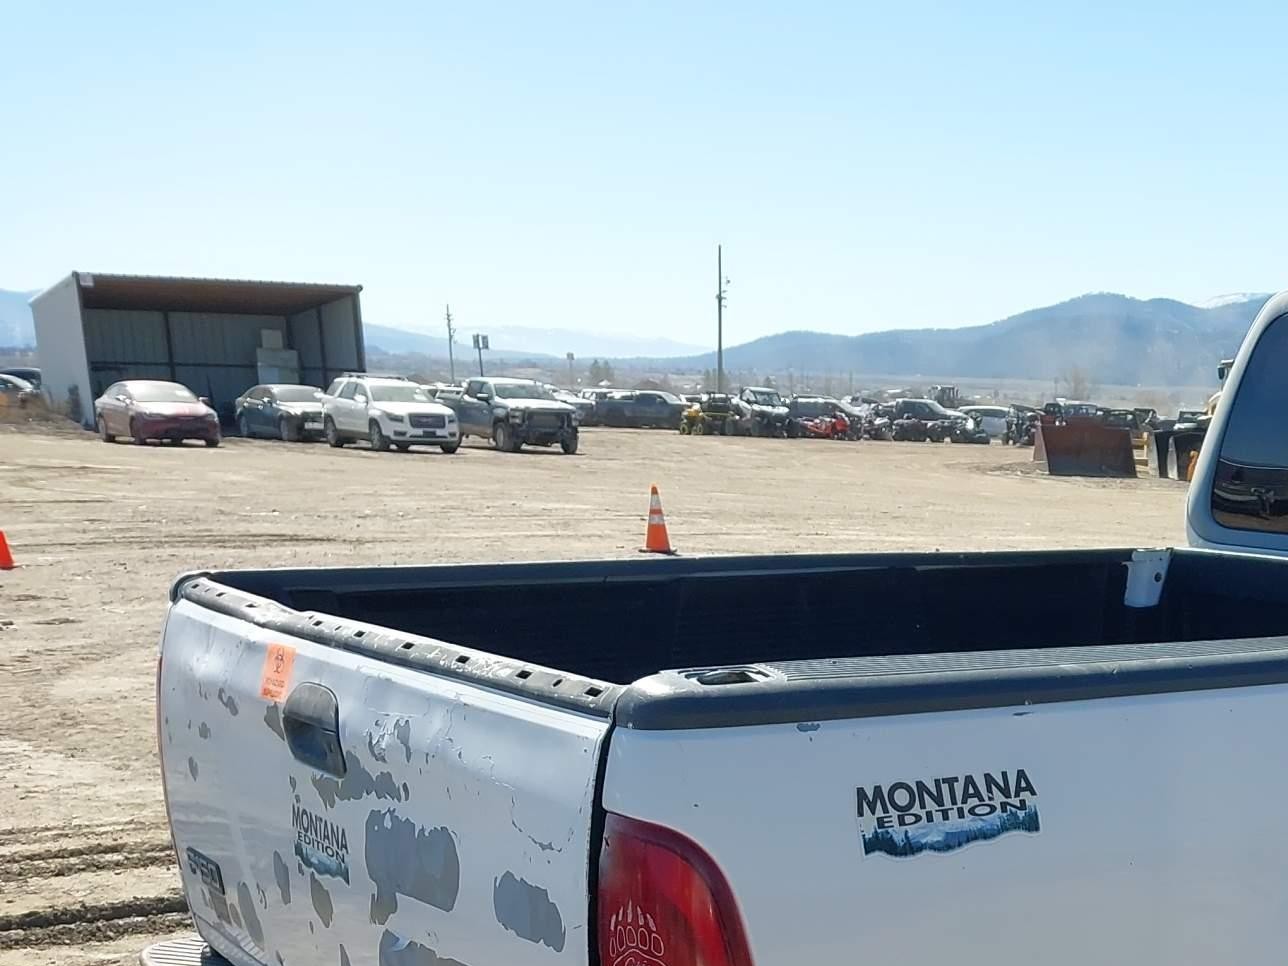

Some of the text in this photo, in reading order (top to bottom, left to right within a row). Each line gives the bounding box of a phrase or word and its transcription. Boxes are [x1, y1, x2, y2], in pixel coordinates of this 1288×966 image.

[856, 768, 1038, 818] MONTANA
[876, 798, 1027, 830] EDITION
[292, 803, 349, 855] MONTANA
[297, 830, 346, 865] EDITION
